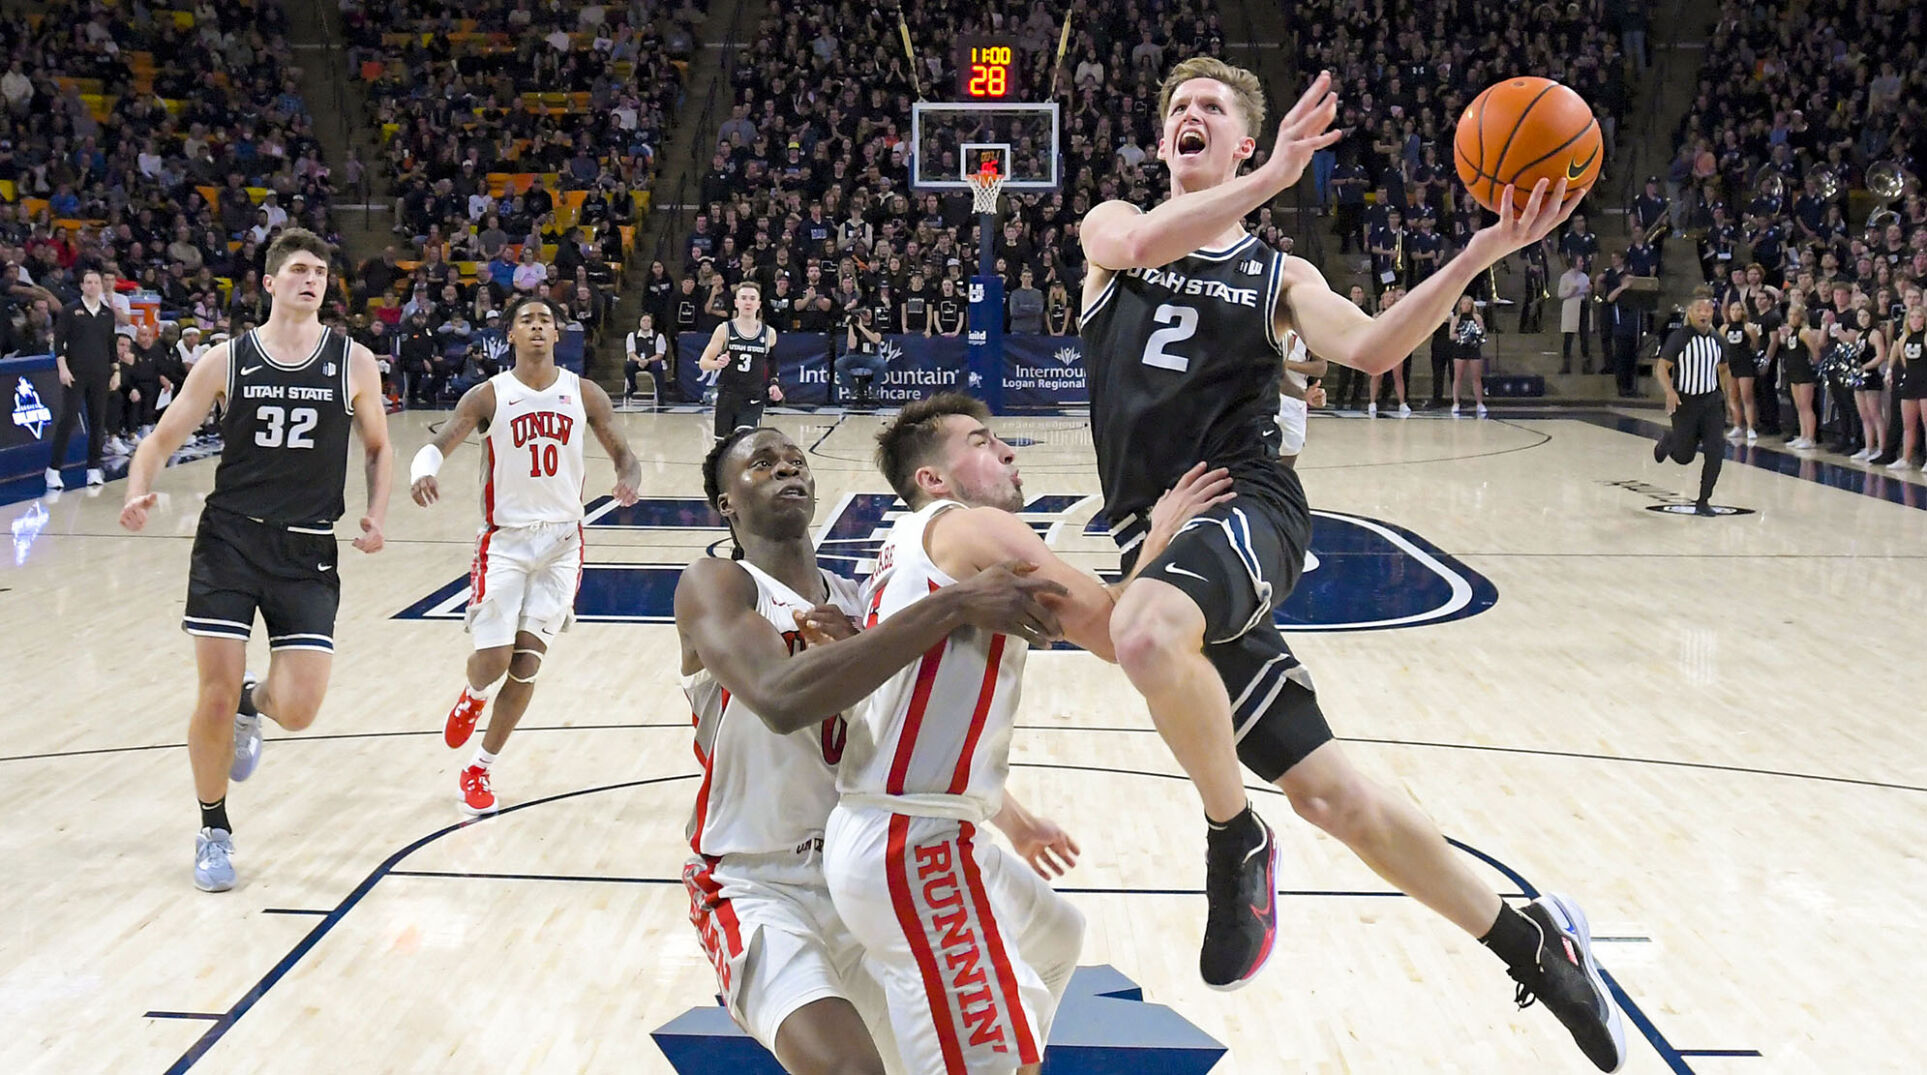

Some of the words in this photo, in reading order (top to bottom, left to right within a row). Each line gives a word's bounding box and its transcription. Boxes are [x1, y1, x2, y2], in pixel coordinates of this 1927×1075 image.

[971, 46, 1011, 65] 11:00
[969, 65, 1006, 96] 28
[1126, 267, 1186, 294] UTAH
[1184, 279, 1258, 308] STATE
[1141, 303, 1199, 373] 2
[737, 353, 752, 372] 3
[243, 385, 284, 398] UTAH
[287, 386, 333, 401] STATE
[1002, 378, 1035, 390] Logan
[1038, 378, 1086, 390] Regional
[254, 405, 318, 449] 32
[510, 411, 574, 448] UNLV
[529, 443, 558, 477] 10
[914, 840, 1008, 1053] RUNNIN'
